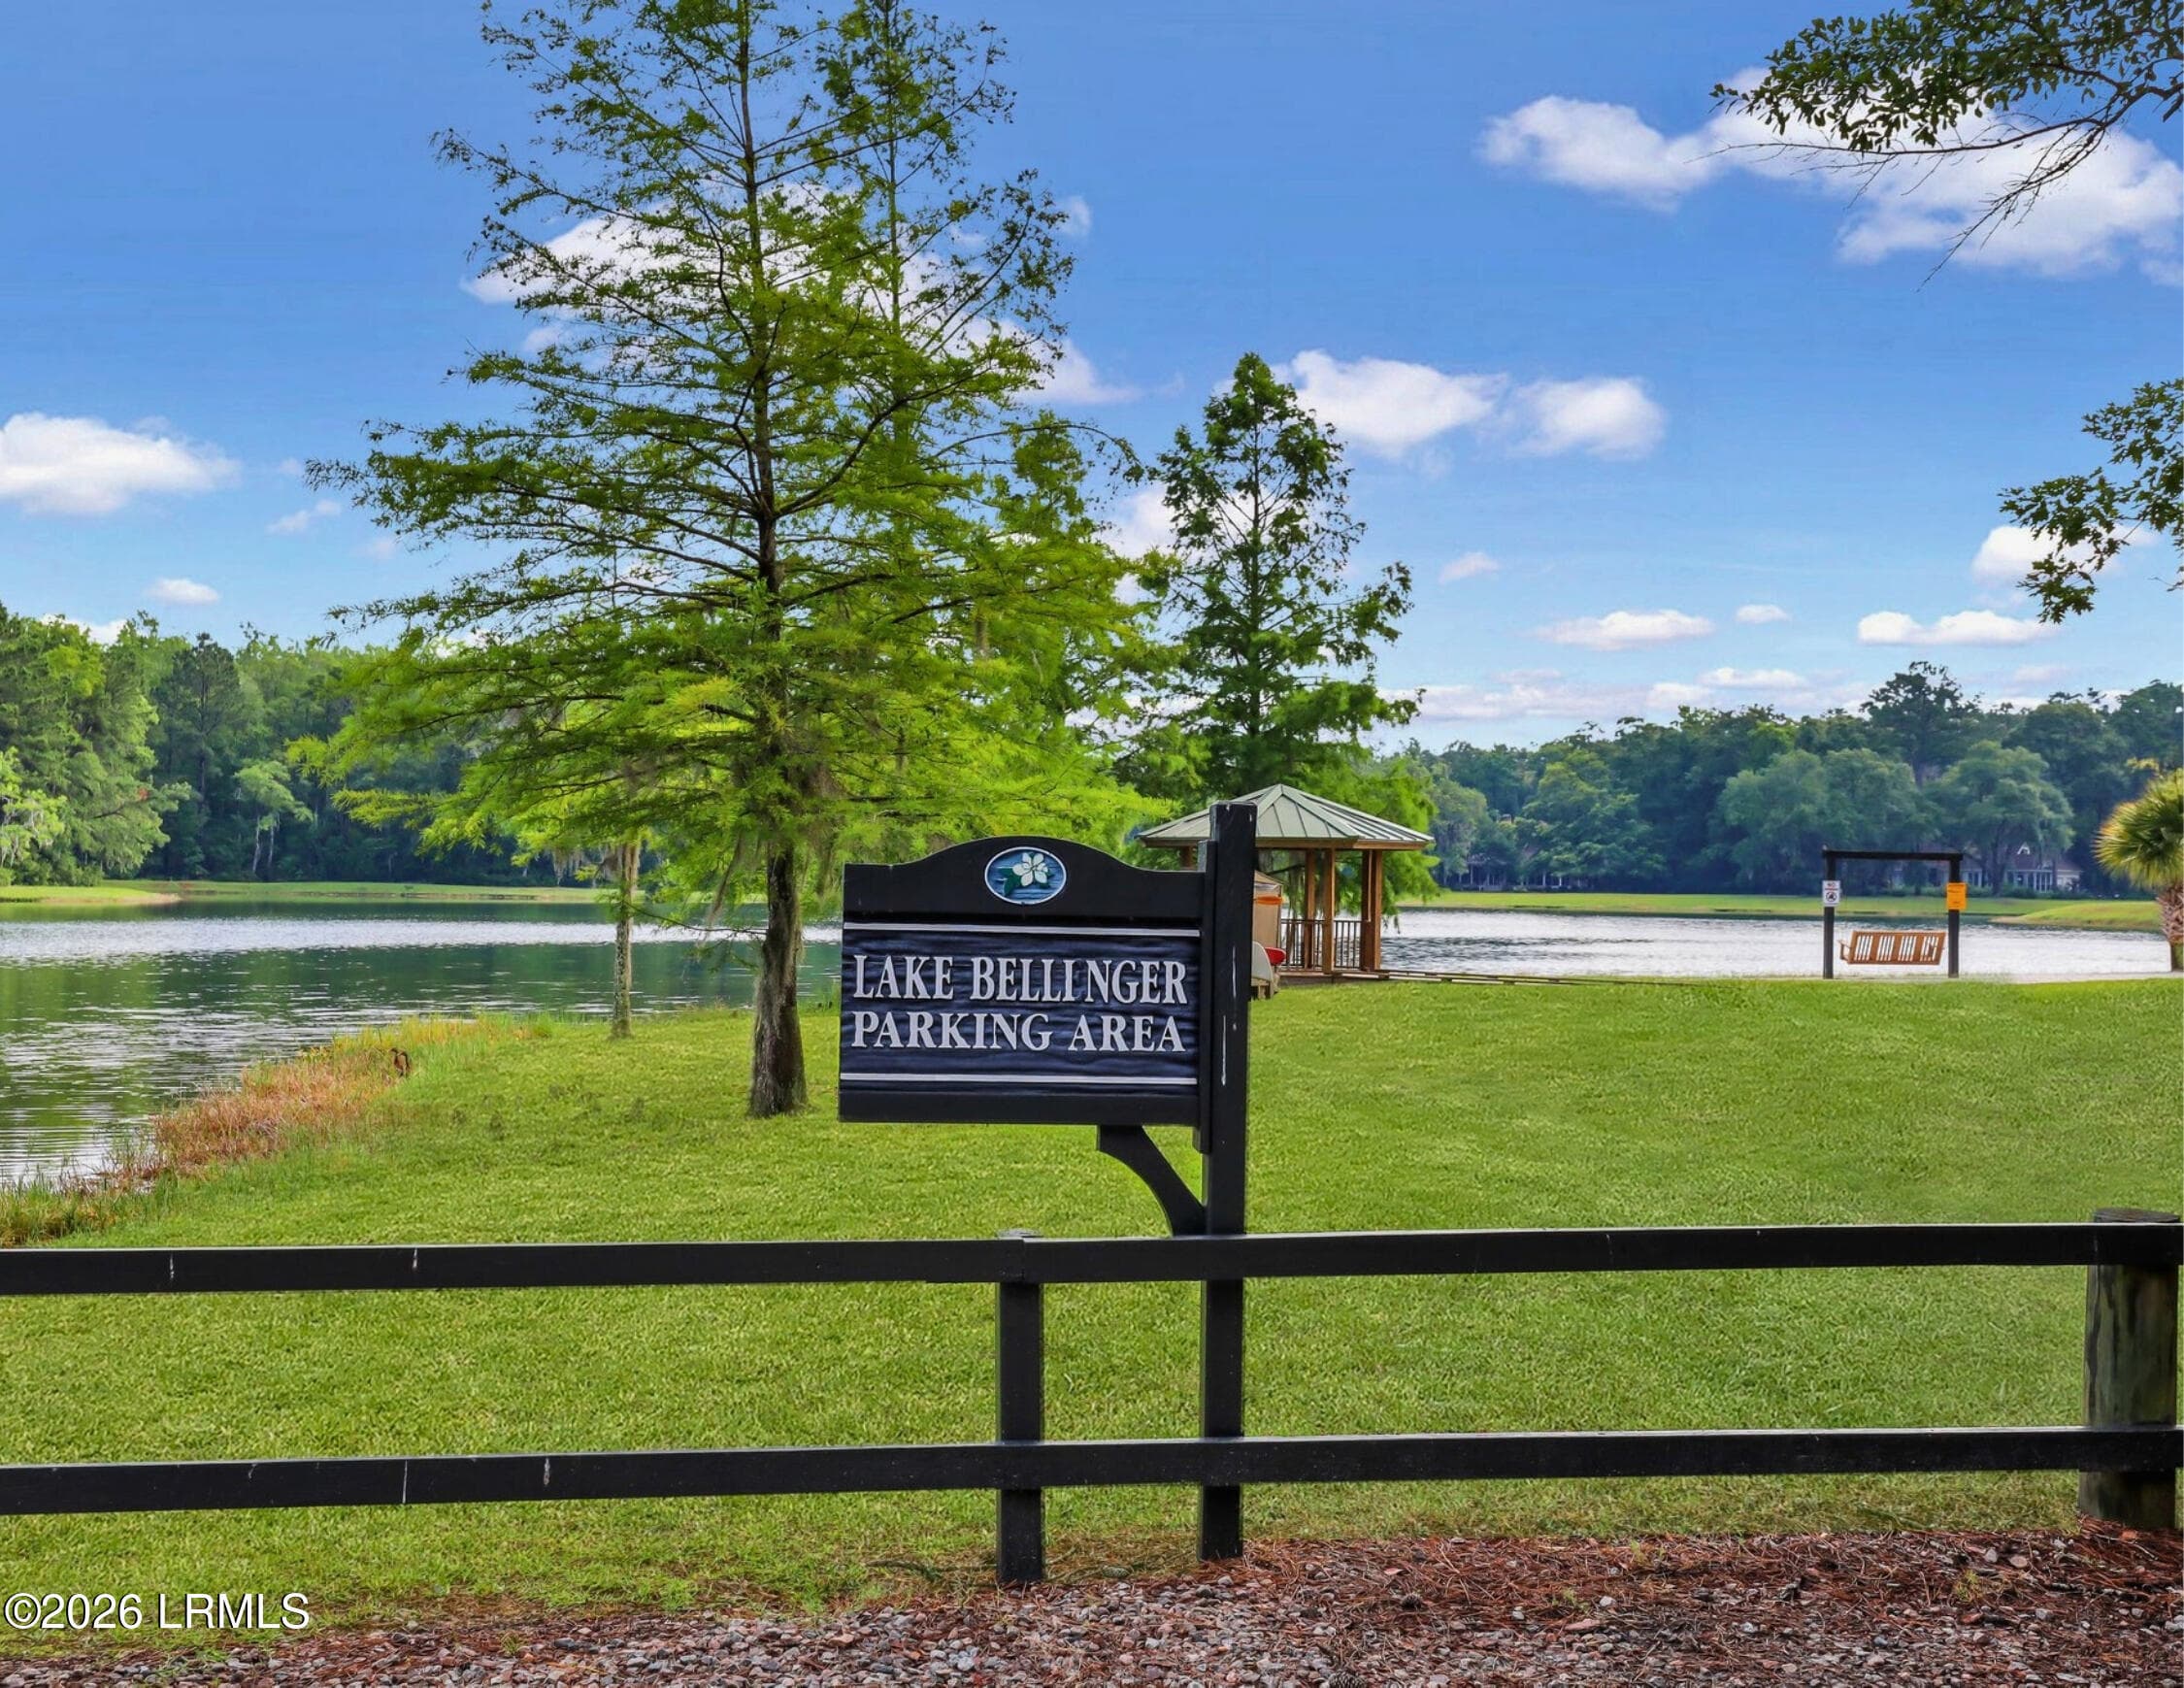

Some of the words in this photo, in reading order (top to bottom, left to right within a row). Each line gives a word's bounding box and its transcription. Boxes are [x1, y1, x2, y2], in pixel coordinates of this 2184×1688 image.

[853, 955, 954, 1000] LAKE
[971, 957, 1187, 1004] BELLINGER
[851, 1010, 1053, 1051] PARKING
[1068, 1015, 1186, 1052] AREA
